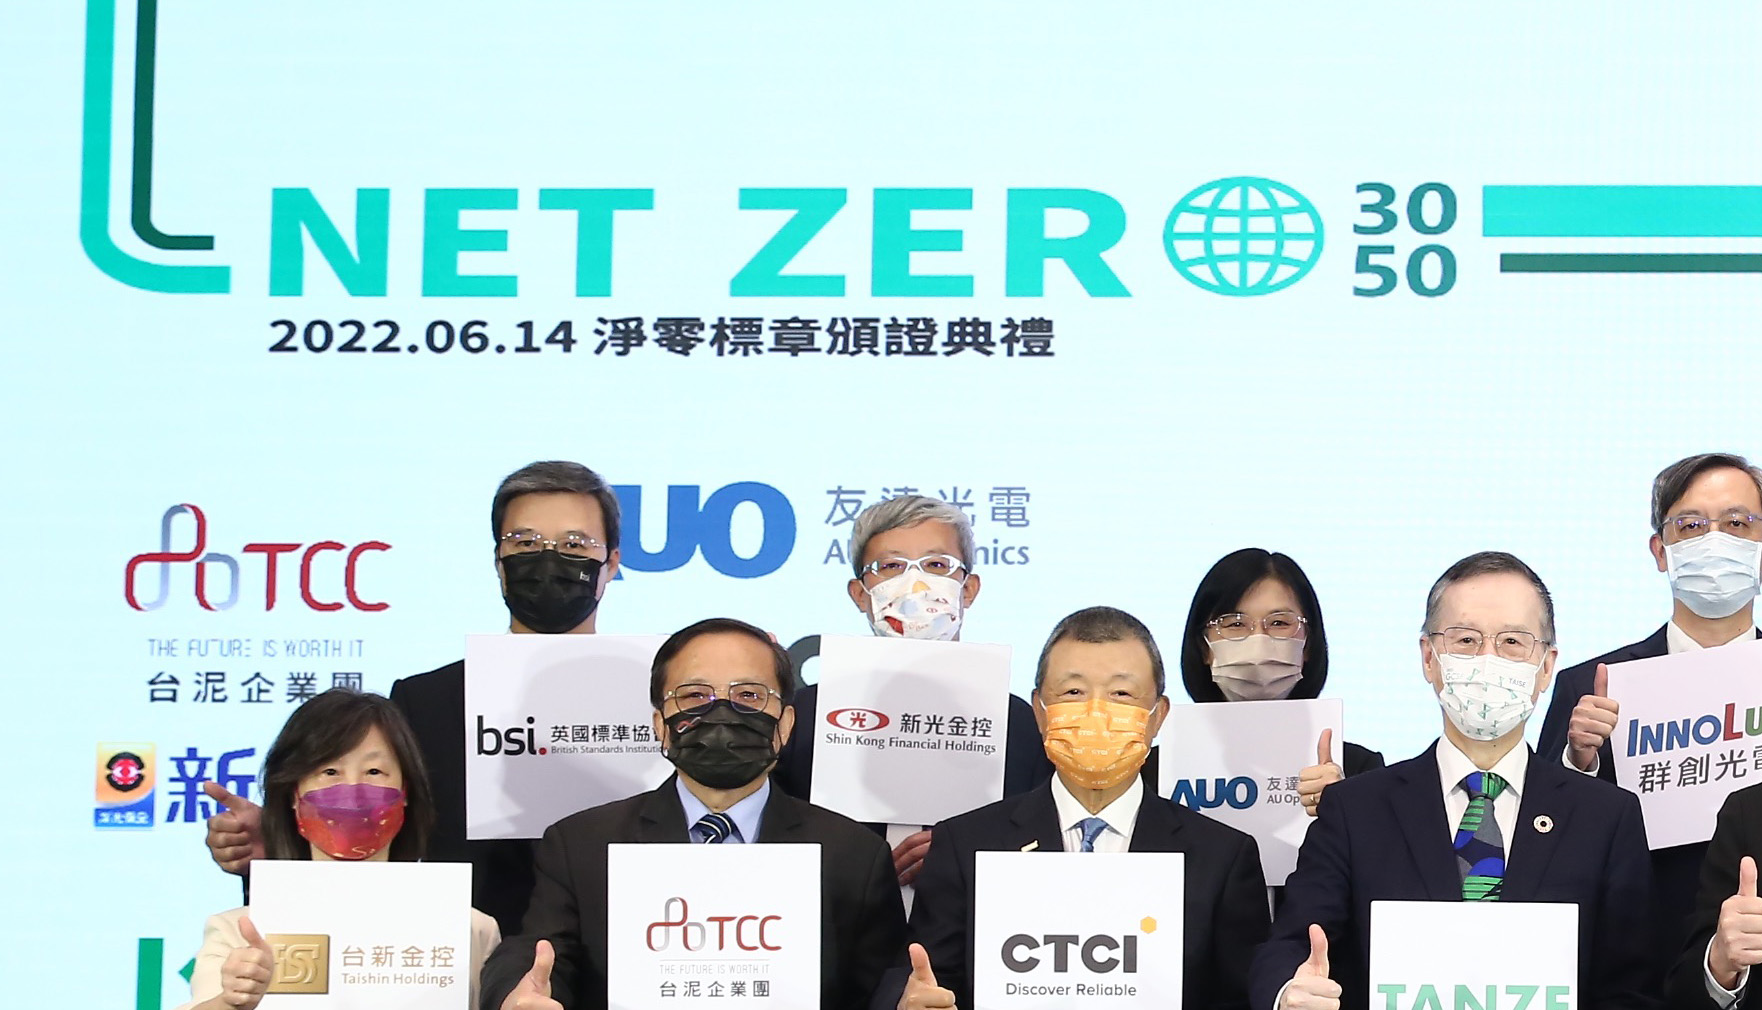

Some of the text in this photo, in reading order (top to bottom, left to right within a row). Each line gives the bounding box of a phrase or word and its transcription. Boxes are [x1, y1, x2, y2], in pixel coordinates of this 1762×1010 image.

[1352, 181, 1457, 236] 30
[269, 187, 655, 298] NET
[1352, 243, 1457, 299] 50
[268, 316, 1056, 358] 2022.06.14 淨零標章頒證典禮
[611, 480, 797, 581] UO
[242, 540, 393, 612] TCC
[147, 638, 179, 658] THE
[550, 725, 661, 742] 英國標準協
[900, 712, 993, 738] 新光金控
[550, 745, 663, 755] British Standards Instituti
[825, 732, 997, 755] Shin Kong Financial Holdings
[1266, 794, 1282, 804] AU
[706, 915, 783, 951] TCC
[341, 945, 455, 968] 台新金控
[1001, 933, 1138, 974] CTCI
[341, 972, 455, 988] Taishin Holdings
[660, 964, 770, 975] THE FUTURE IS WORTH IT
[659, 980, 770, 998] 台泥企業團
[1006, 982, 1137, 996] Discover Reliable
